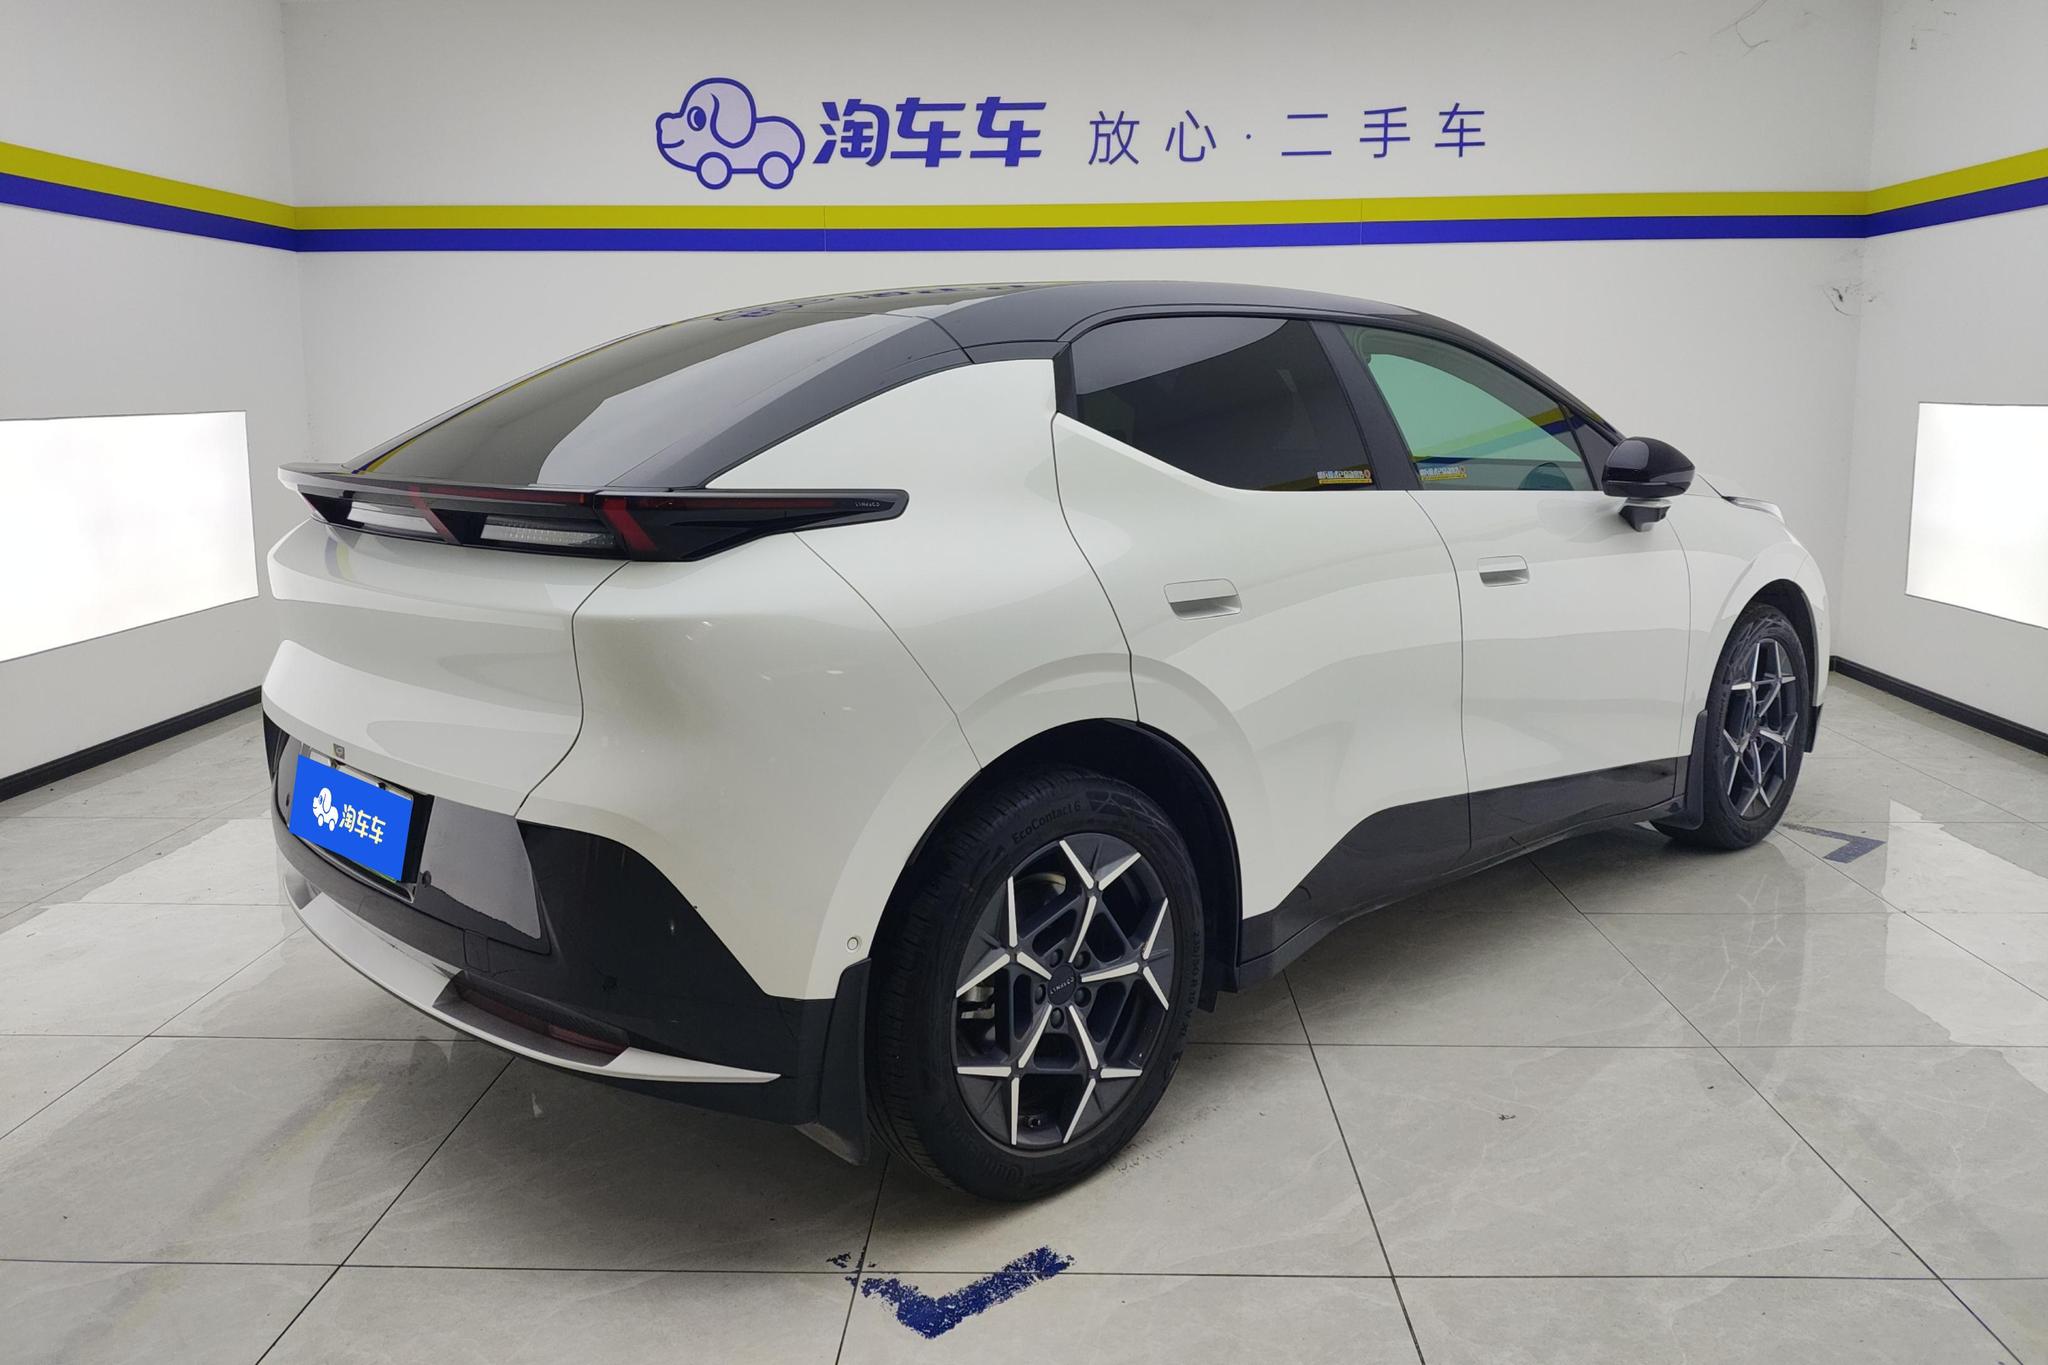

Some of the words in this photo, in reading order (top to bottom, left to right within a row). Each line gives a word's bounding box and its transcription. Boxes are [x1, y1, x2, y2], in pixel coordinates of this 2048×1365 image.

[813, 96, 1047, 168] 淘车车
[1012, 802, 1074, 845] EcoContact
[1073, 799, 1081, 813] 6
